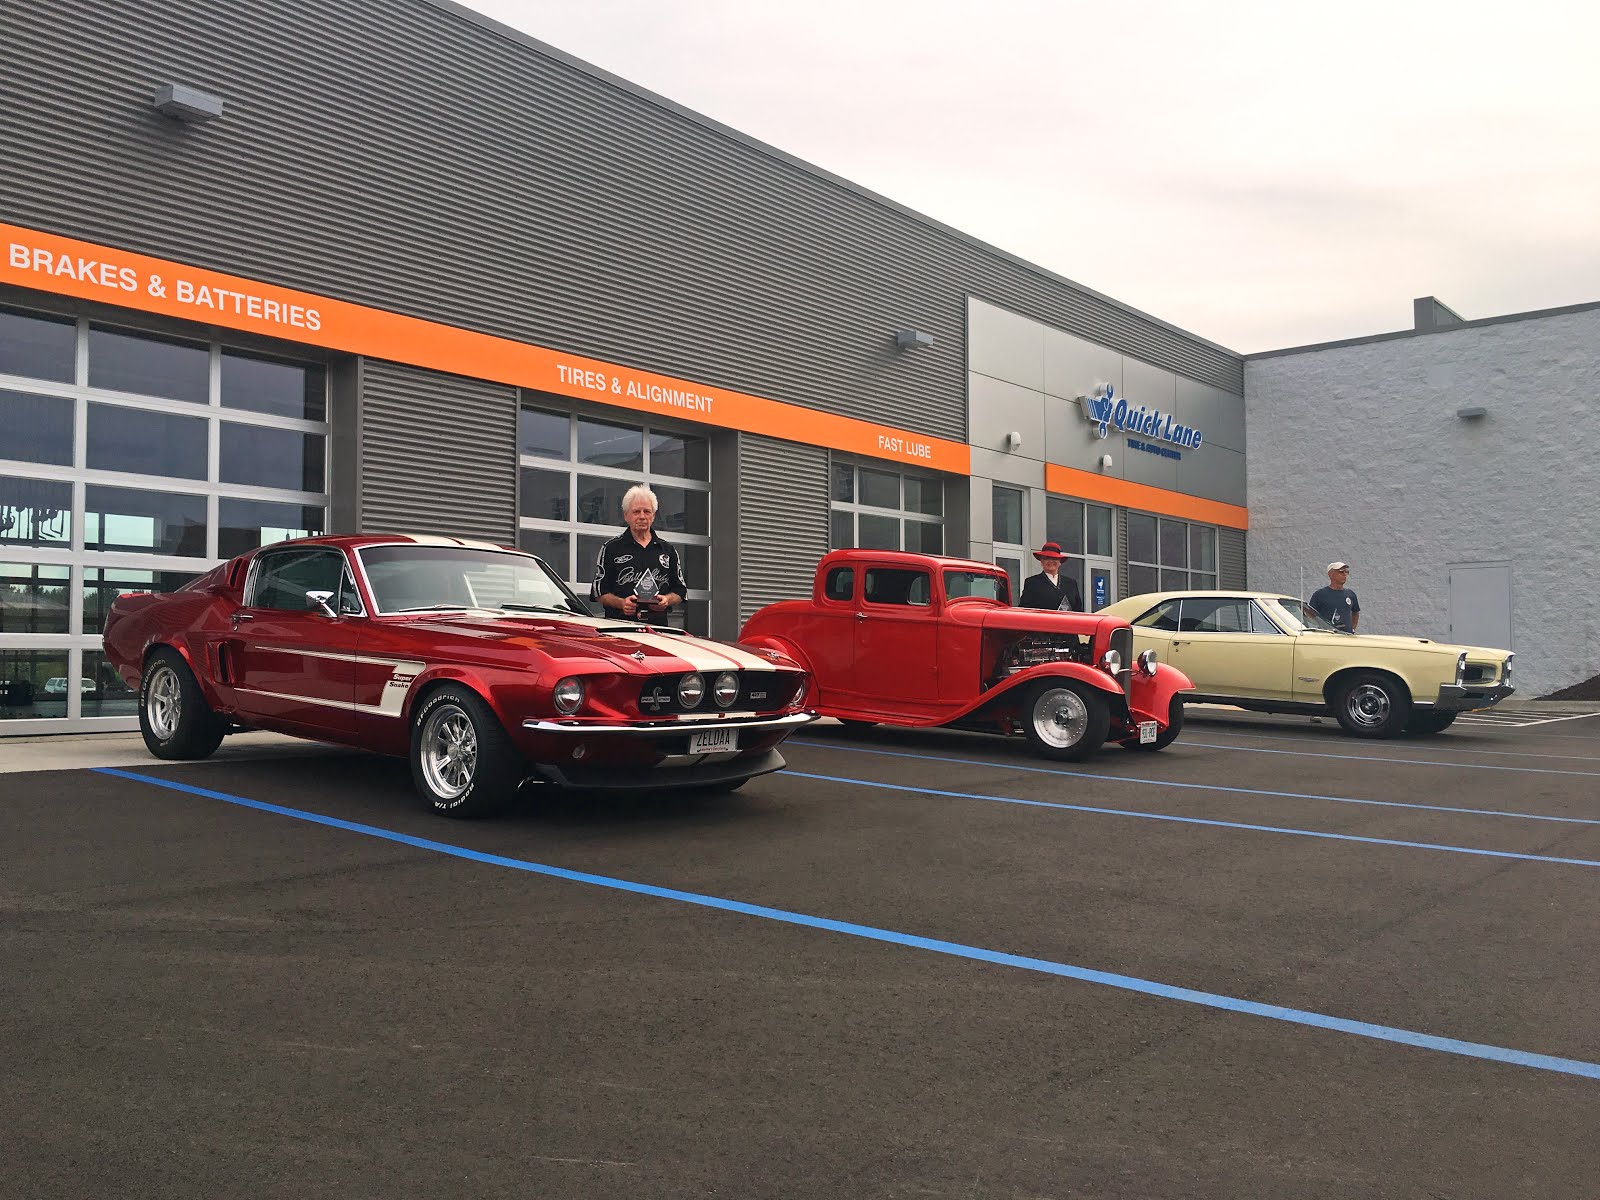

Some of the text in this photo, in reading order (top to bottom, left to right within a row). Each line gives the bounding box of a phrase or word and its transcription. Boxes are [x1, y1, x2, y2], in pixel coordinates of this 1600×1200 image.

[9, 243, 321, 331] BRAKES & BATTERIES
[556, 364, 713, 413] TIRES & ALIGNMENT
[1114, 398, 1202, 450] Quick Lane
[878, 435, 932, 459] FAST LUBE
[393, 673, 412, 681] Super
[696, 729, 730, 746] ZELDAA
